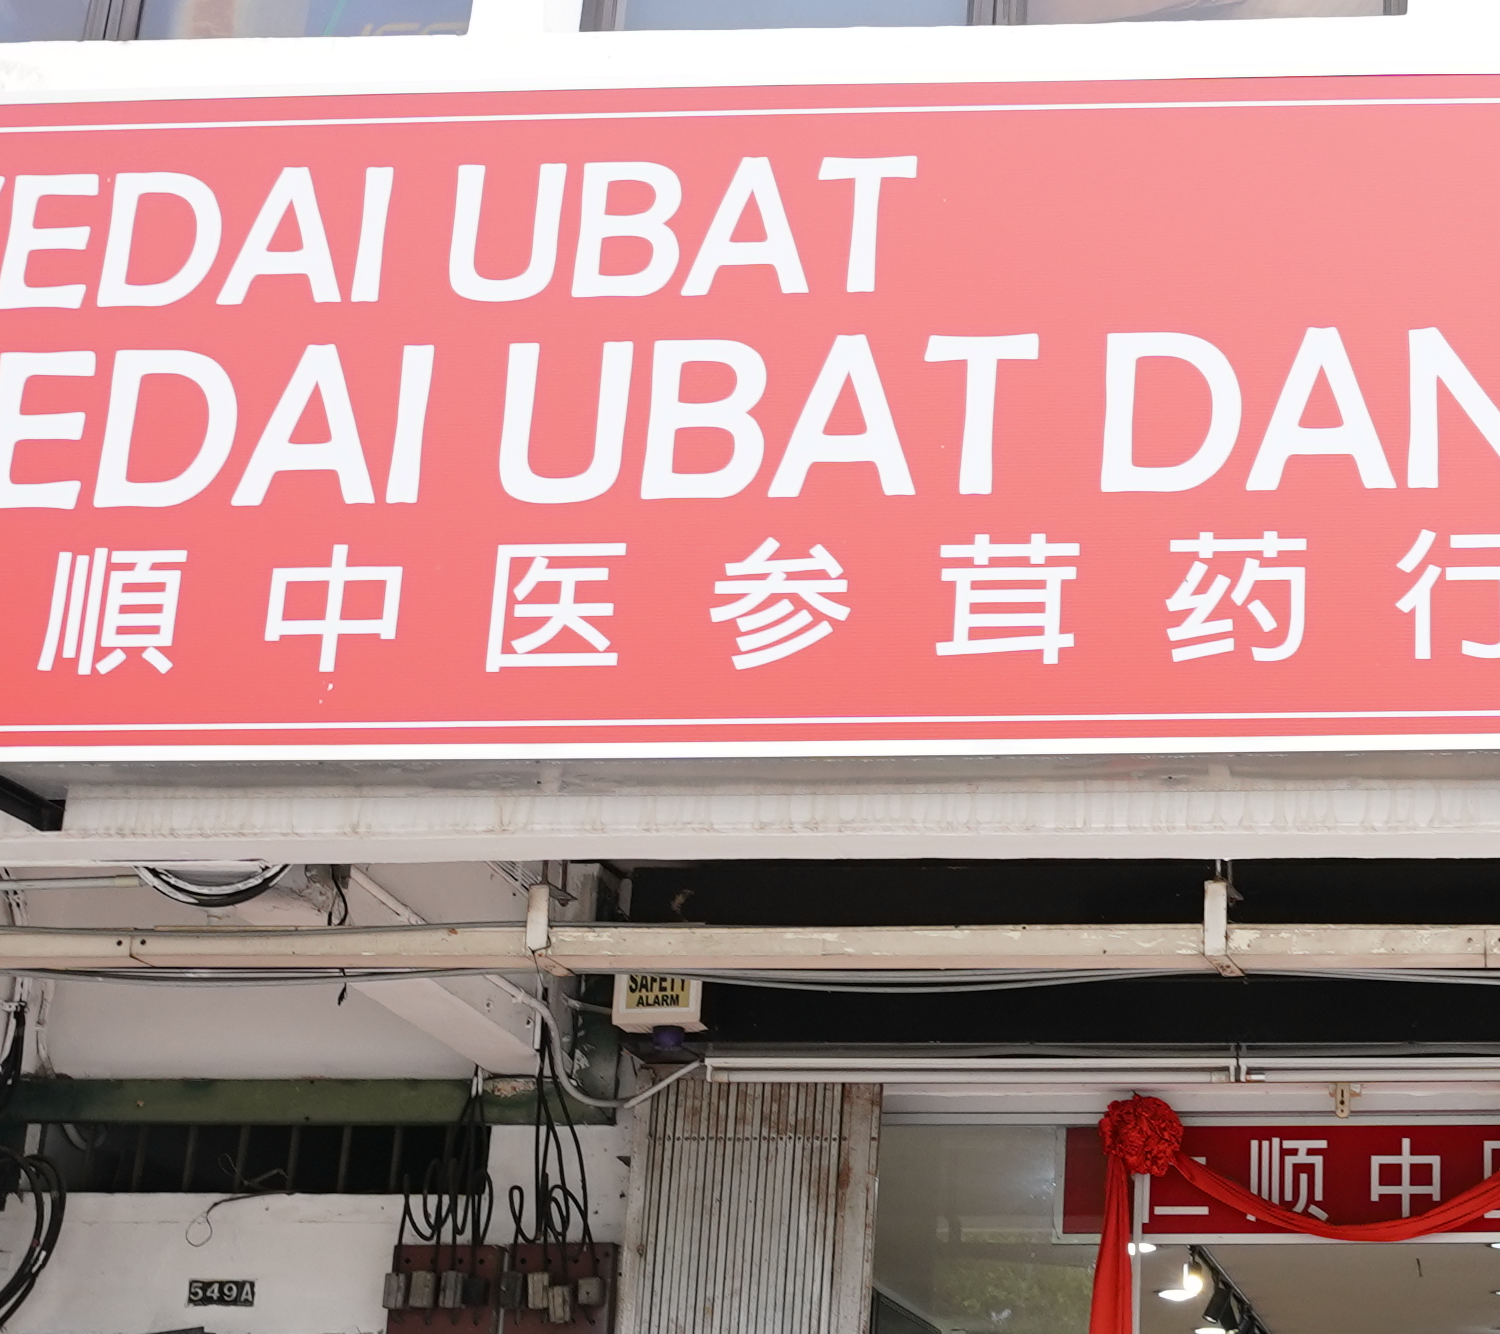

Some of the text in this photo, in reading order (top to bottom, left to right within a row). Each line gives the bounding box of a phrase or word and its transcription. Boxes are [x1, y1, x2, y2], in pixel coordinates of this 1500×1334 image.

[449, 156, 918, 303] UBAT
[499, 333, 1040, 504] UBAT
[636, 994, 680, 1007] ALARM
[189, 1282, 253, 1302] 549A
